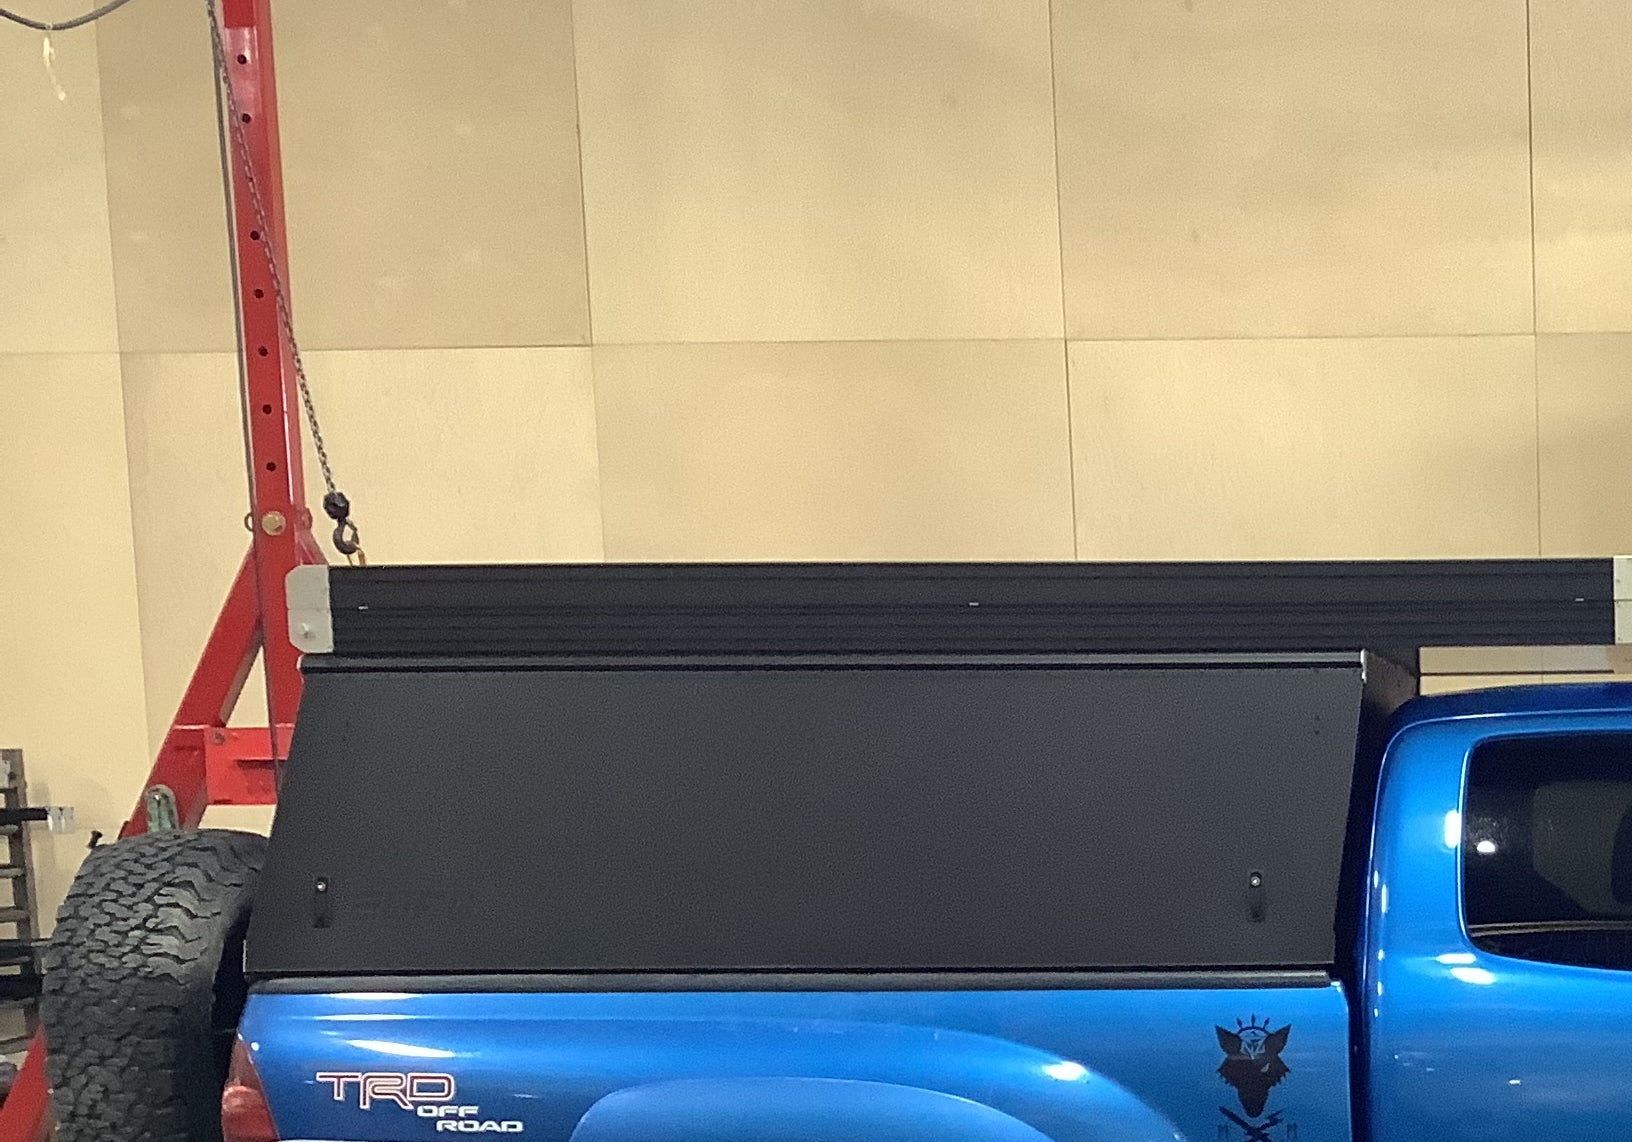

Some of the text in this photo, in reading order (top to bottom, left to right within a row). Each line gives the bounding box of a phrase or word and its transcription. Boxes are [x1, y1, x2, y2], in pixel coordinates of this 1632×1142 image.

[316, 1072, 455, 1110] TRD
[416, 1105, 480, 1118] OFF
[436, 1119, 525, 1133] ROAD
